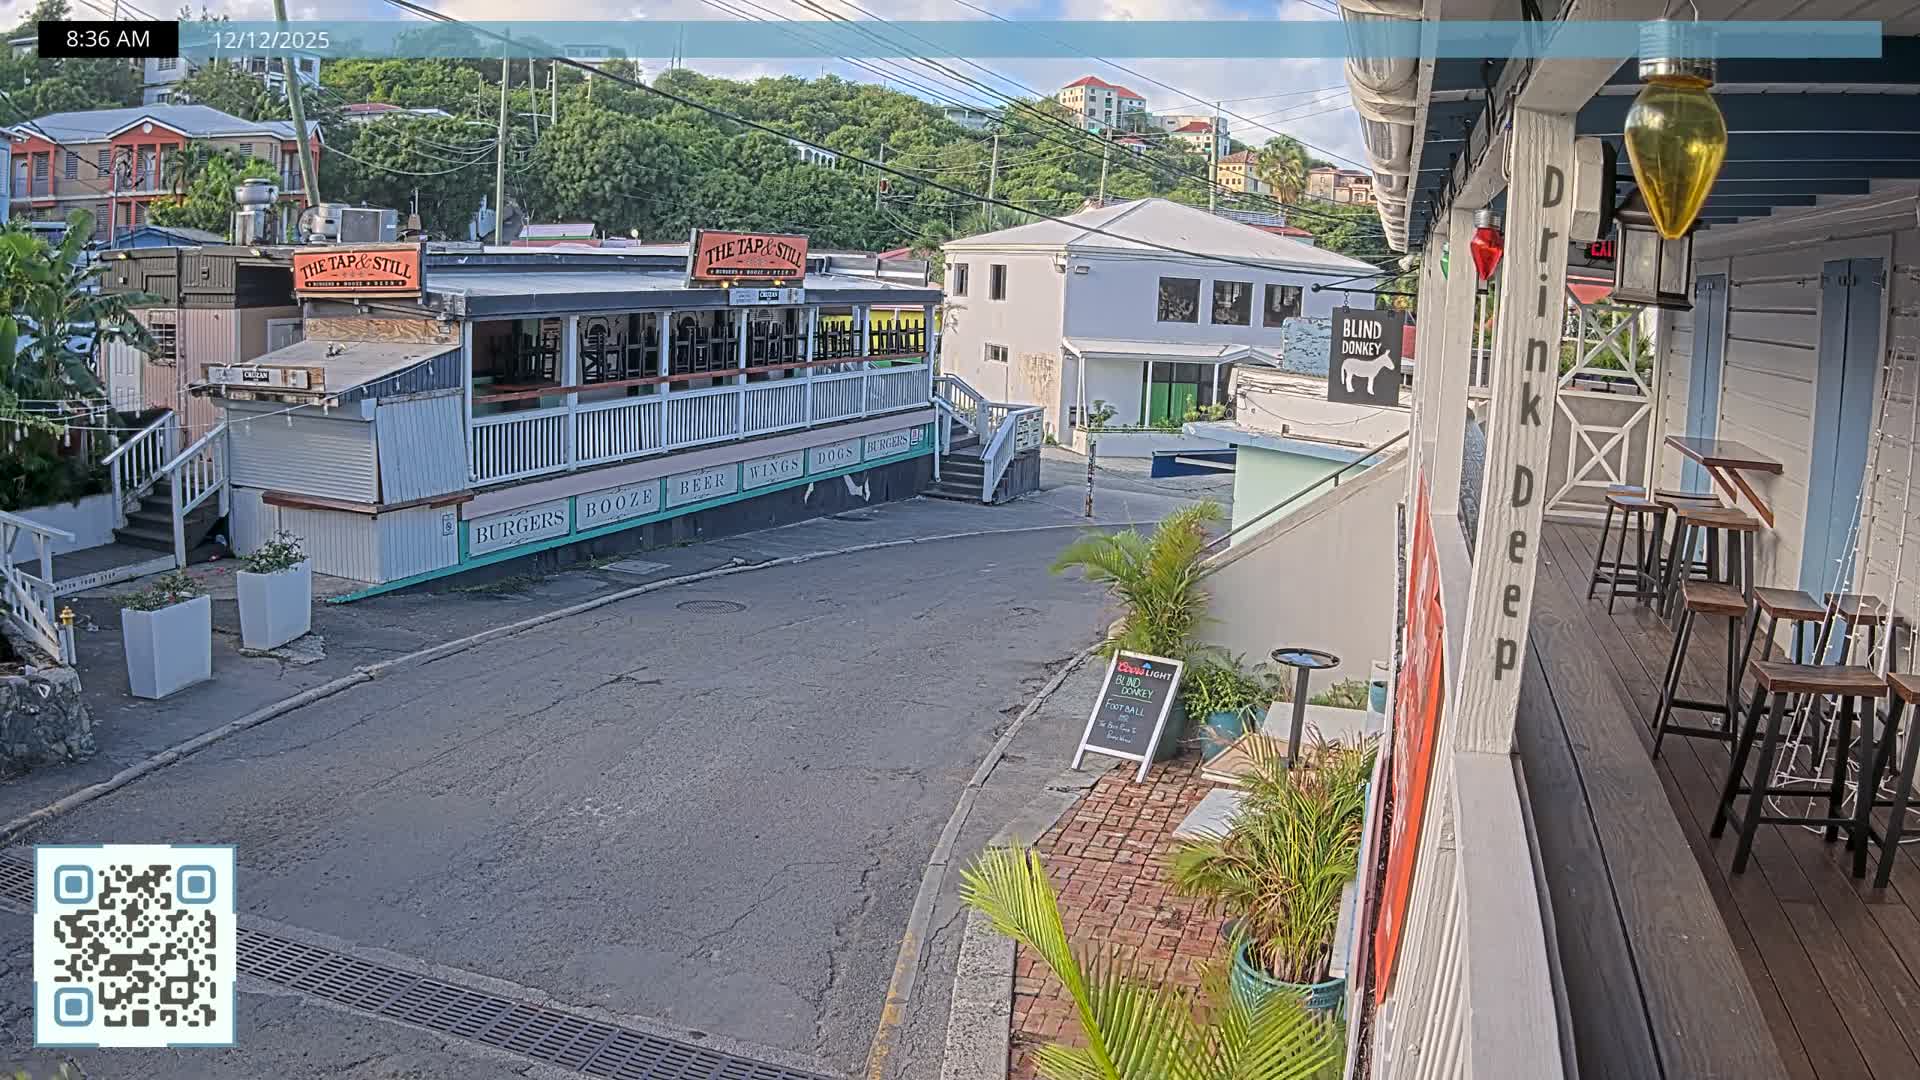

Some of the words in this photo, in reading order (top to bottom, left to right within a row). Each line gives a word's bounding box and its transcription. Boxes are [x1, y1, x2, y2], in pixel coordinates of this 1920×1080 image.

[704, 241, 736, 266] THE
[738, 237, 764, 256] TAP
[761, 238, 777, 256] &
[776, 242, 802, 268] STILL
[301, 259, 328, 279] THE
[328, 254, 357, 271] TAP
[355, 254, 373, 271] &
[372, 256, 412, 279] STILL
[1520, 164, 1564, 428] Drink
[1343, 318, 1382, 340] BLIND
[1341, 340, 1382, 356] DONKEY
[243, 371, 268, 379] CRUZAN
[866, 435, 908, 454] BURGERS
[818, 446, 854, 465] DOGS
[750, 460, 799, 481] WINGS
[680, 472, 725, 496] BEER
[585, 489, 653, 519] BOOZE
[476, 510, 566, 545] BURGERS
[1493, 463, 1534, 683] Deep
[1115, 675, 1141, 689] BLIND
[1145, 669, 1173, 681] LIGHT
[1121, 687, 1154, 700] DONKEY
